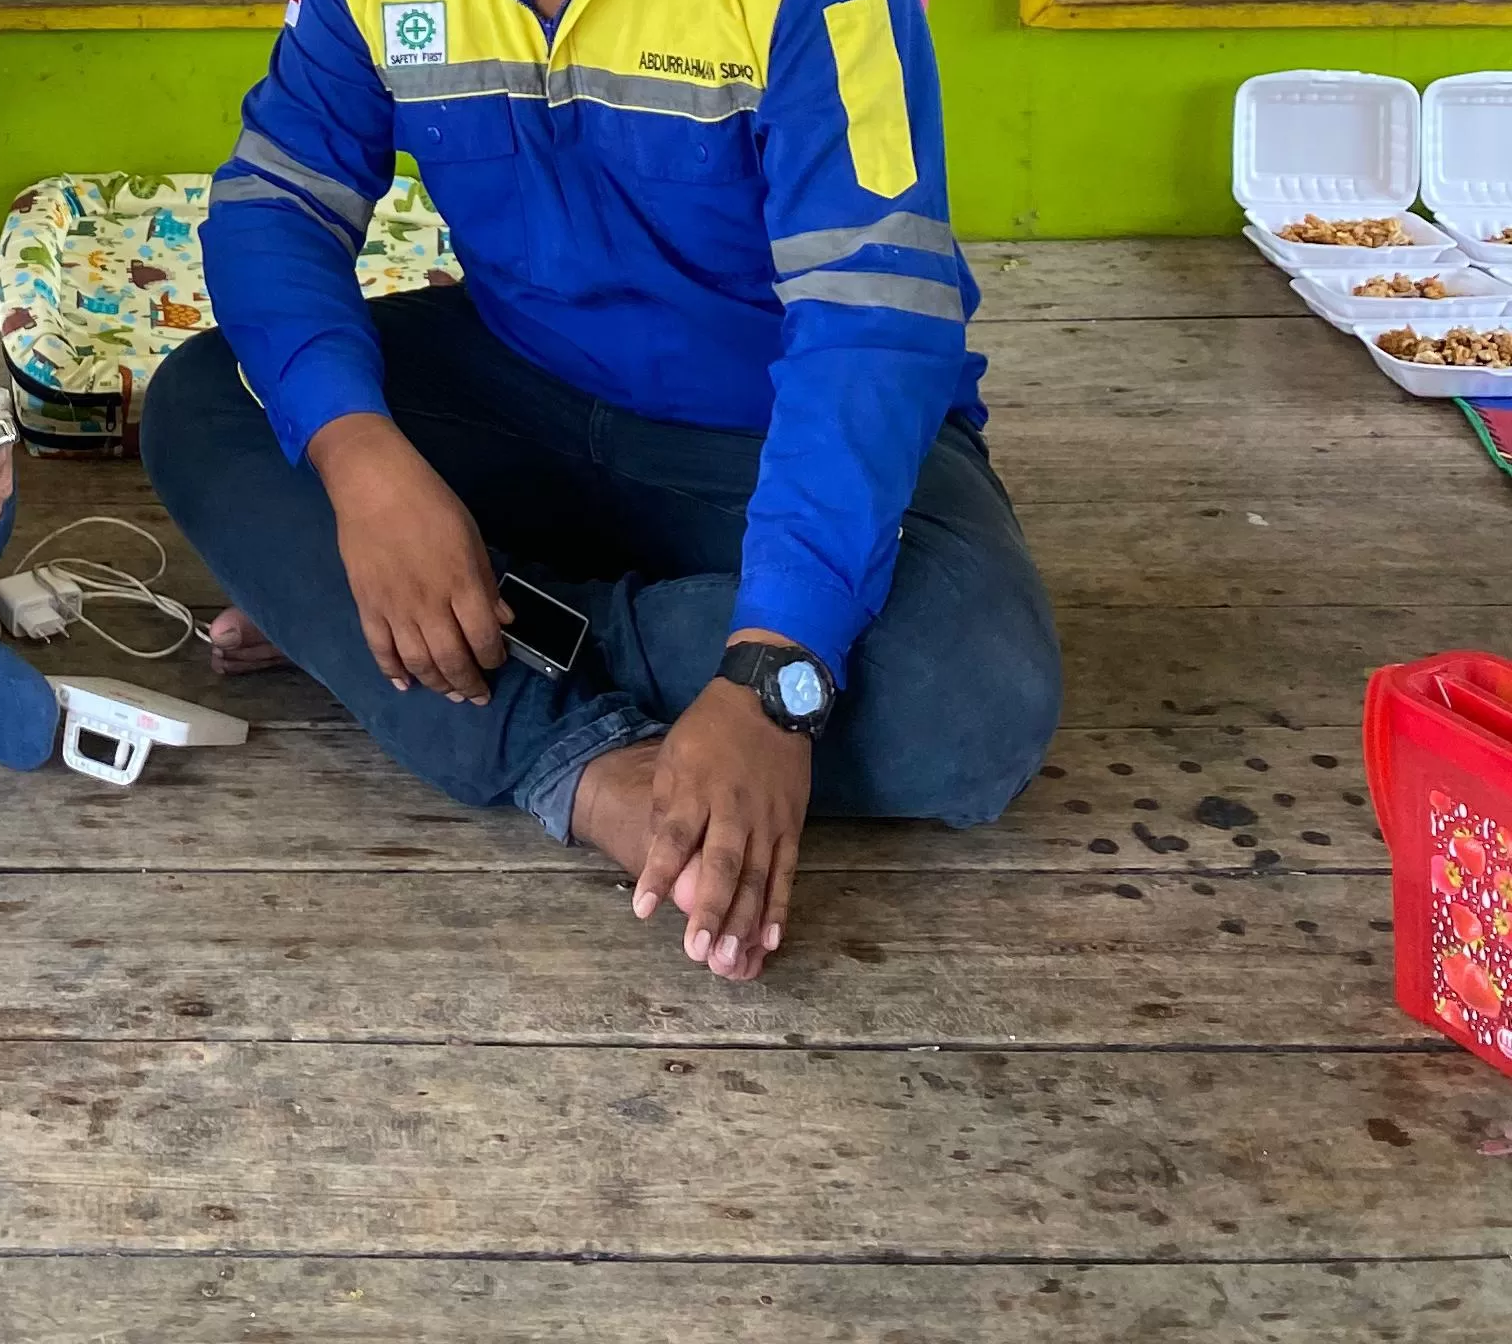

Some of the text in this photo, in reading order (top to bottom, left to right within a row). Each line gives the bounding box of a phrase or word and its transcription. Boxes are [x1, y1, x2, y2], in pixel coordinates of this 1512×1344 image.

[390, 52, 443, 65] SAFETY FIRST
[639, 51, 755, 82] ABDURRAHMAN SIDIQ
